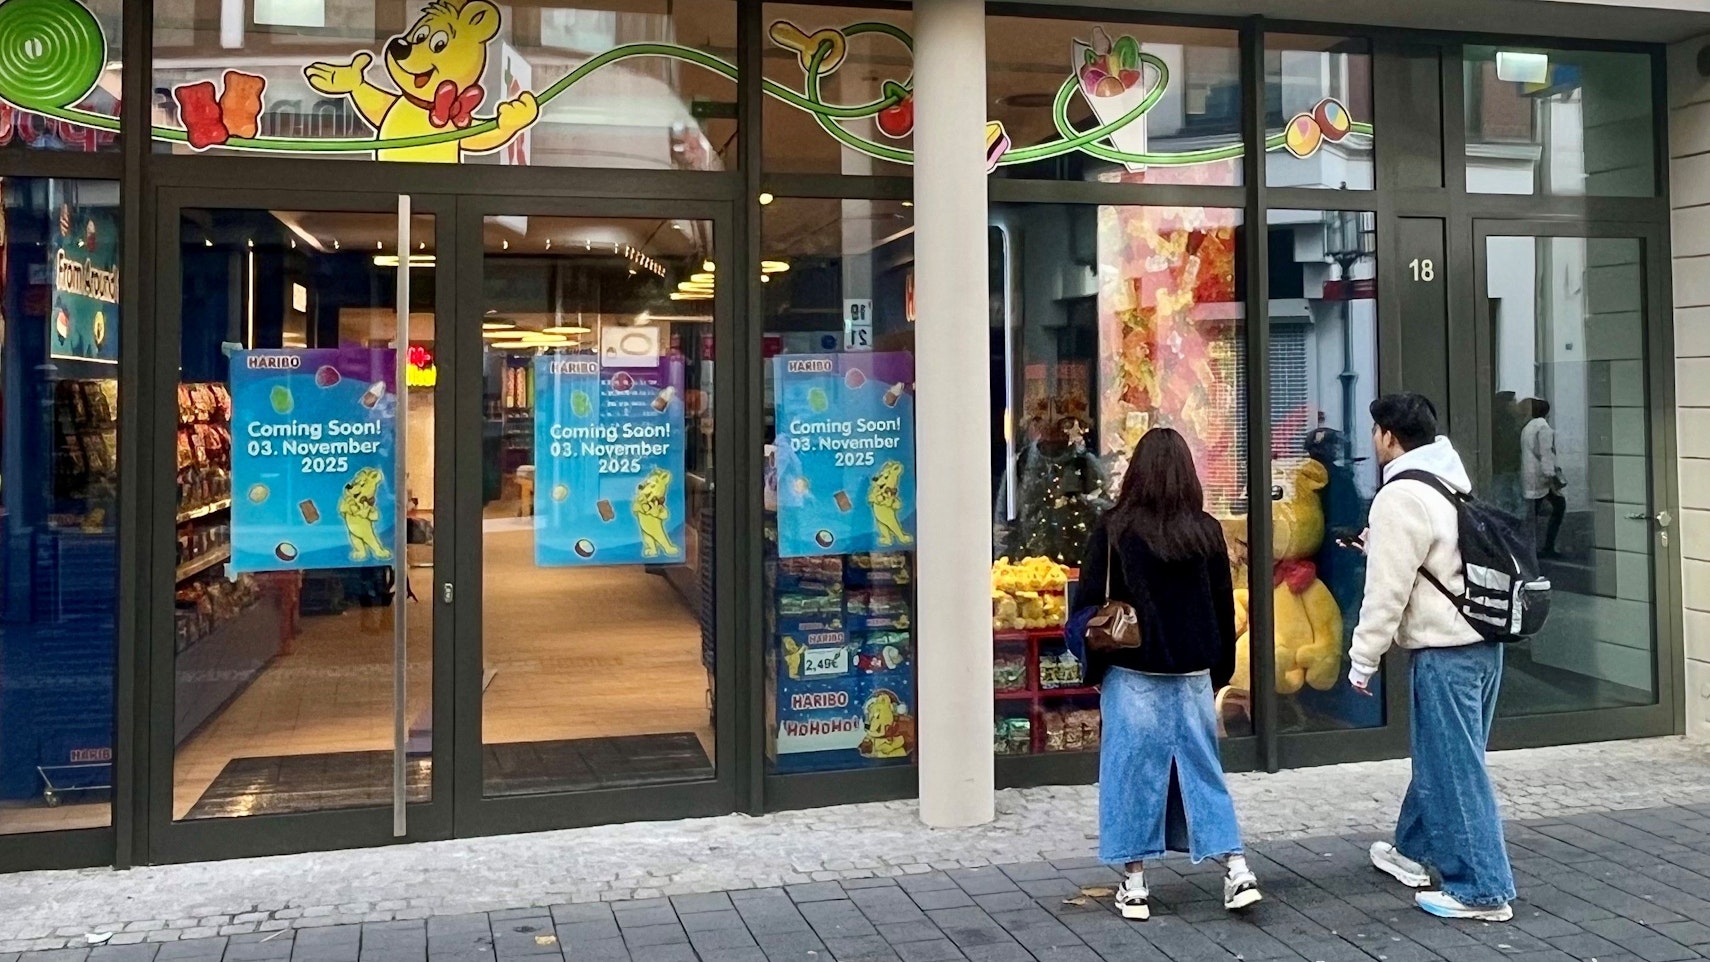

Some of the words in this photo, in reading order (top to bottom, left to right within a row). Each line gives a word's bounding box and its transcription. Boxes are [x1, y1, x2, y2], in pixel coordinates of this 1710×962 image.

[1408, 258, 1434, 282] 18
[247, 355, 301, 369] HARIBO
[550, 360, 598, 374] HARIBO
[788, 359, 832, 372] HARIBO
[247, 420, 322, 440] Coming
[328, 419, 381, 435] Soon!
[550, 424, 619, 442] Coming
[622, 422, 671, 439] Soon!
[790, 419, 852, 436] Coming
[856, 417, 901, 432] Soon!
[247, 440, 279, 457] 03.
[282, 438, 381, 456] November
[550, 443, 578, 458] 03.
[581, 441, 670, 457] November
[790, 437, 817, 451] 03.
[819, 434, 900, 451] November
[301, 456, 349, 473] 2025
[598, 458, 642, 474] 2025
[834, 452, 875, 467] 2025
[792, 691, 848, 710] HARIBO
[70, 748, 112, 762] HARIB
